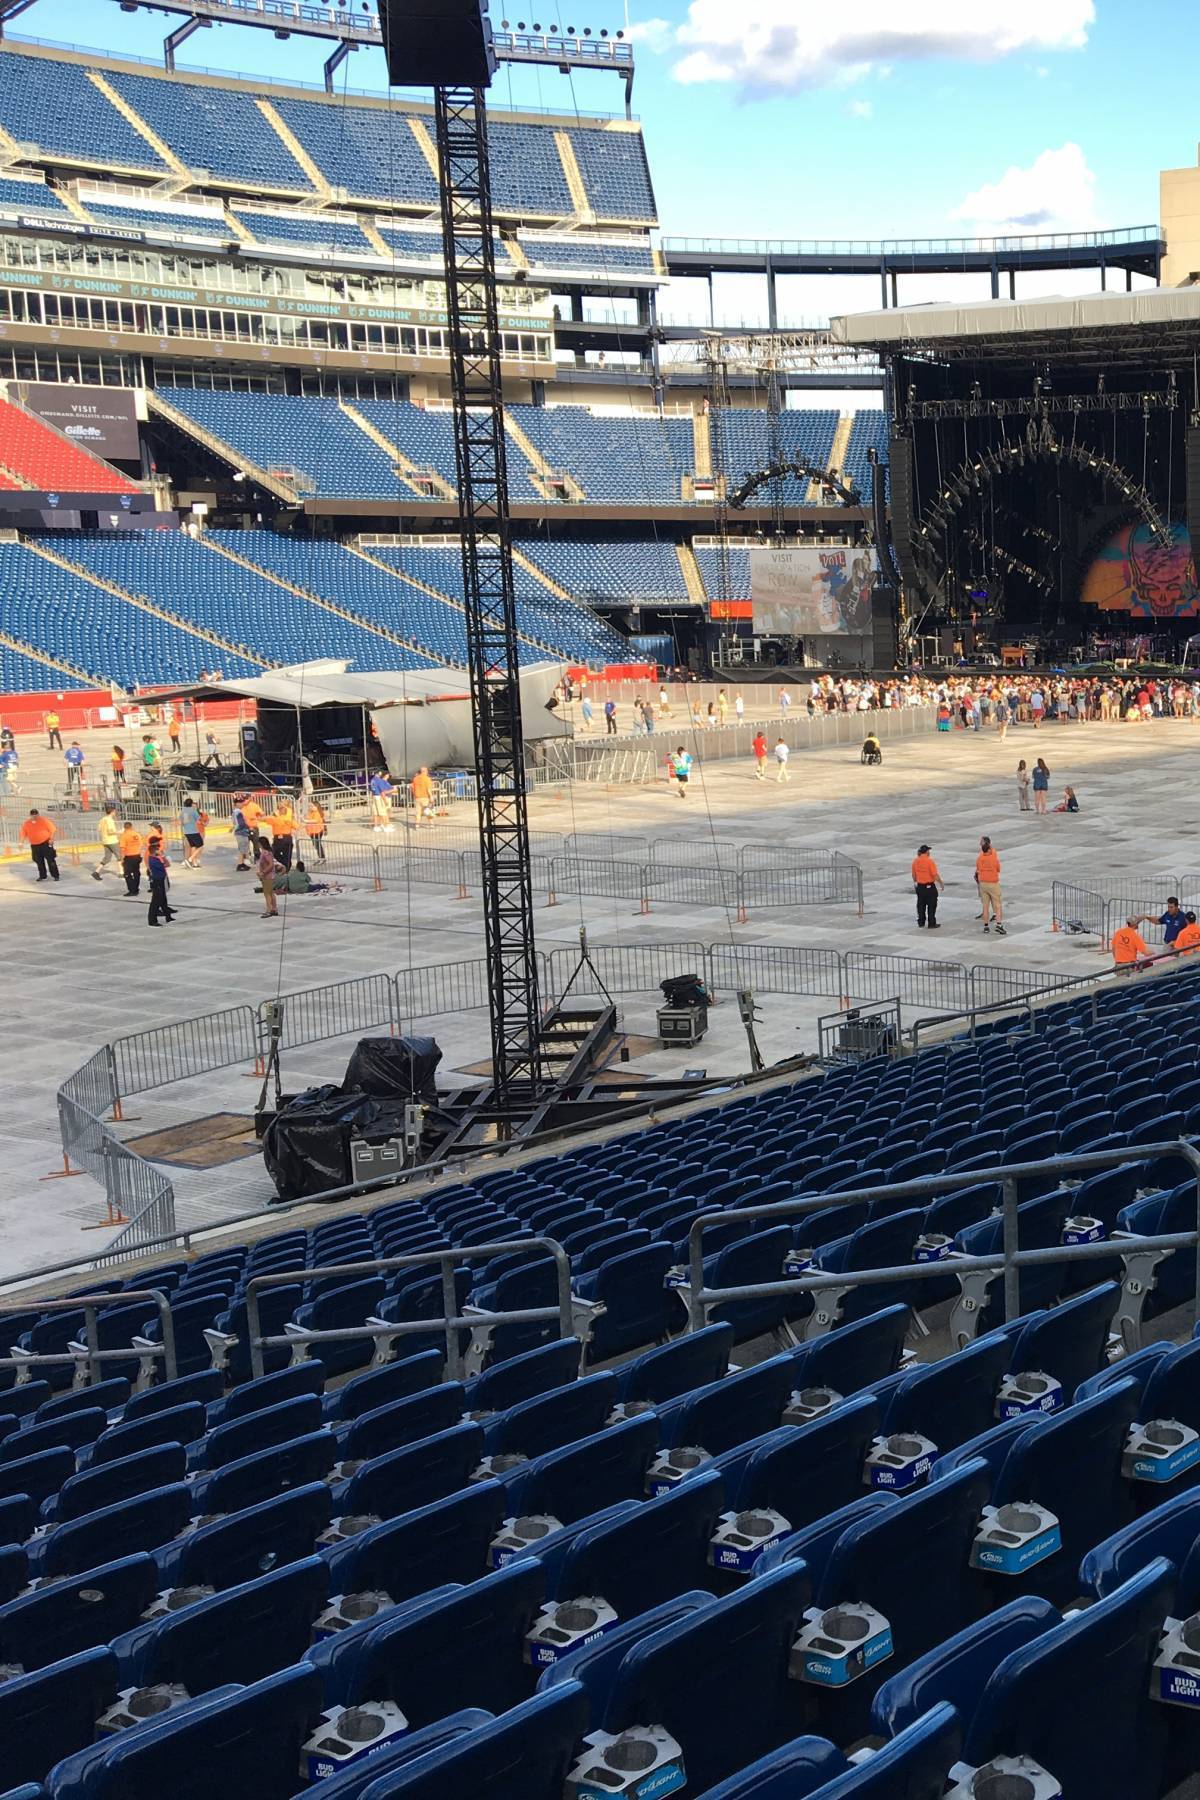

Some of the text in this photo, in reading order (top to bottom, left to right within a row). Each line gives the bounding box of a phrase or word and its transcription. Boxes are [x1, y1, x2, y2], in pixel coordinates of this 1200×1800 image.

[74, 279, 122, 293] DUNKIN'
[151, 287, 198, 300] DUNKIN'
[226, 295, 270, 308] DUNKIN'
[297, 303, 341, 315] DUNKIN'
[508, 317, 550, 329] DUNKIN'
[71, 404, 97, 413] VISIT
[65, 425, 102, 436] Gillette
[772, 553, 793, 563] VISIT
[821, 553, 846, 567] VOTE
[1130, 1283, 1139, 1291] 14
[964, 1300, 974, 1309] 13
[817, 1313, 826, 1322] 12
[915, 1457, 929, 1470] BUD
[912, 1462, 931, 1478] LIGHT
[879, 1472, 893, 1480] BUD
[877, 1477, 896, 1485] LIGHT
[720, 1556, 740, 1564] LIGHT
[540, 1648, 555, 1656] BUD
[537, 1654, 558, 1663] LIGHT
[1174, 1676, 1197, 1688] BUD
[1170, 1684, 1200, 1697] LIGHT
[318, 1763, 334, 1771] BUD
